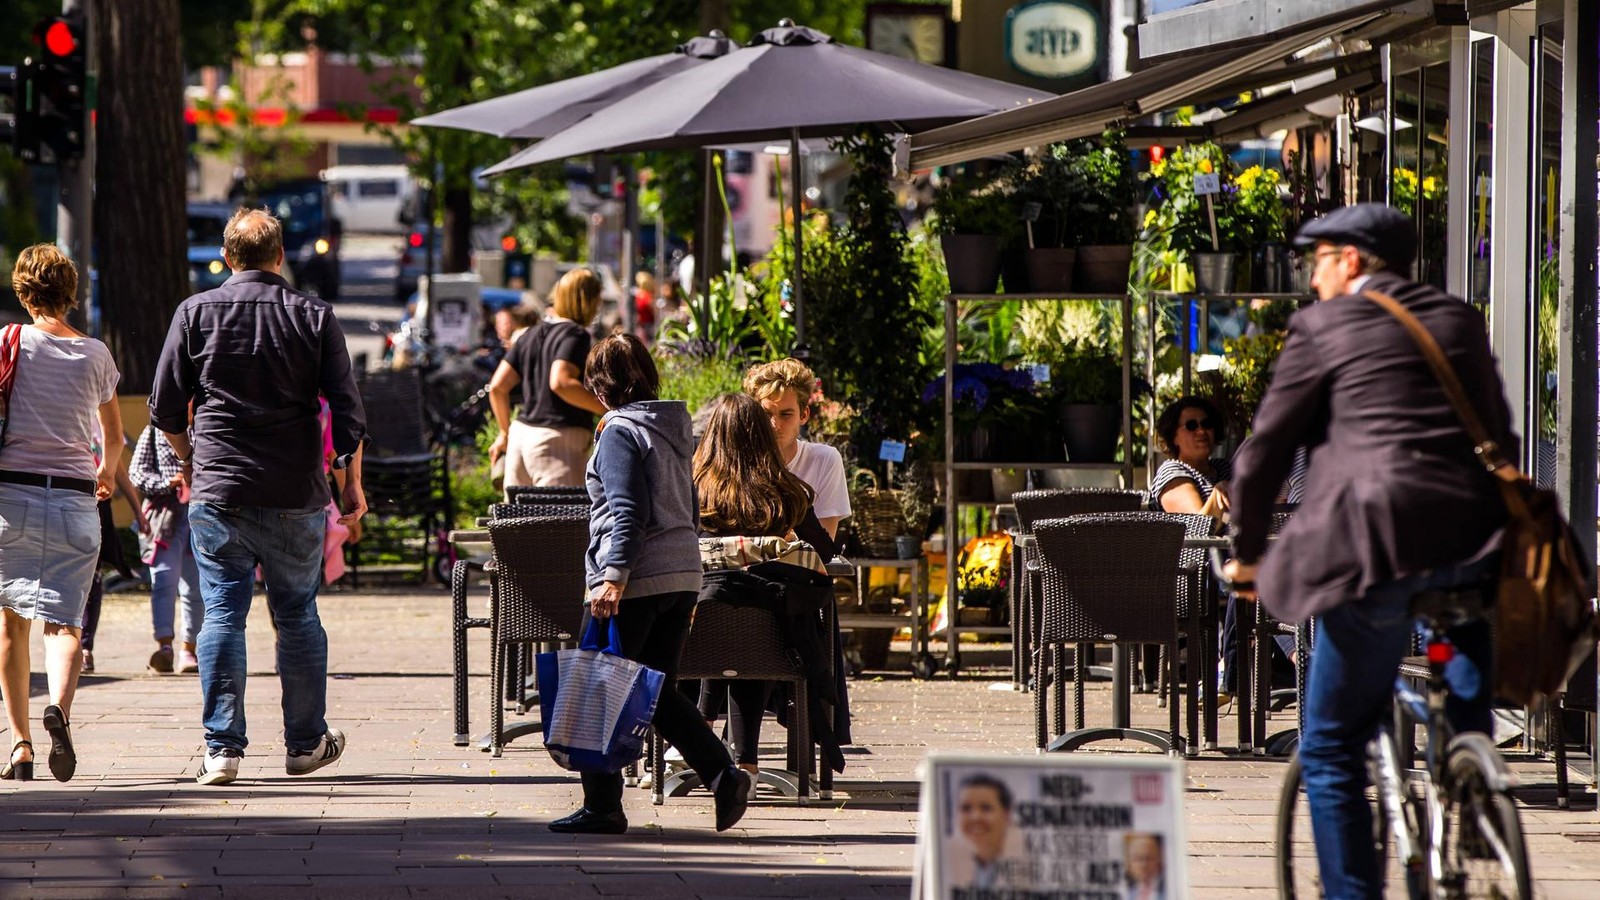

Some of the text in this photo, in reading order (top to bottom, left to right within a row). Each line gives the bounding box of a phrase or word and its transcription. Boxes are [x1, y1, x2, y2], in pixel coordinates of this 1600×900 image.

[1024, 27, 1081, 58] JEVER
[1040, 774, 1093, 799] NEU-
[1018, 802, 1133, 828] SENATORIN
